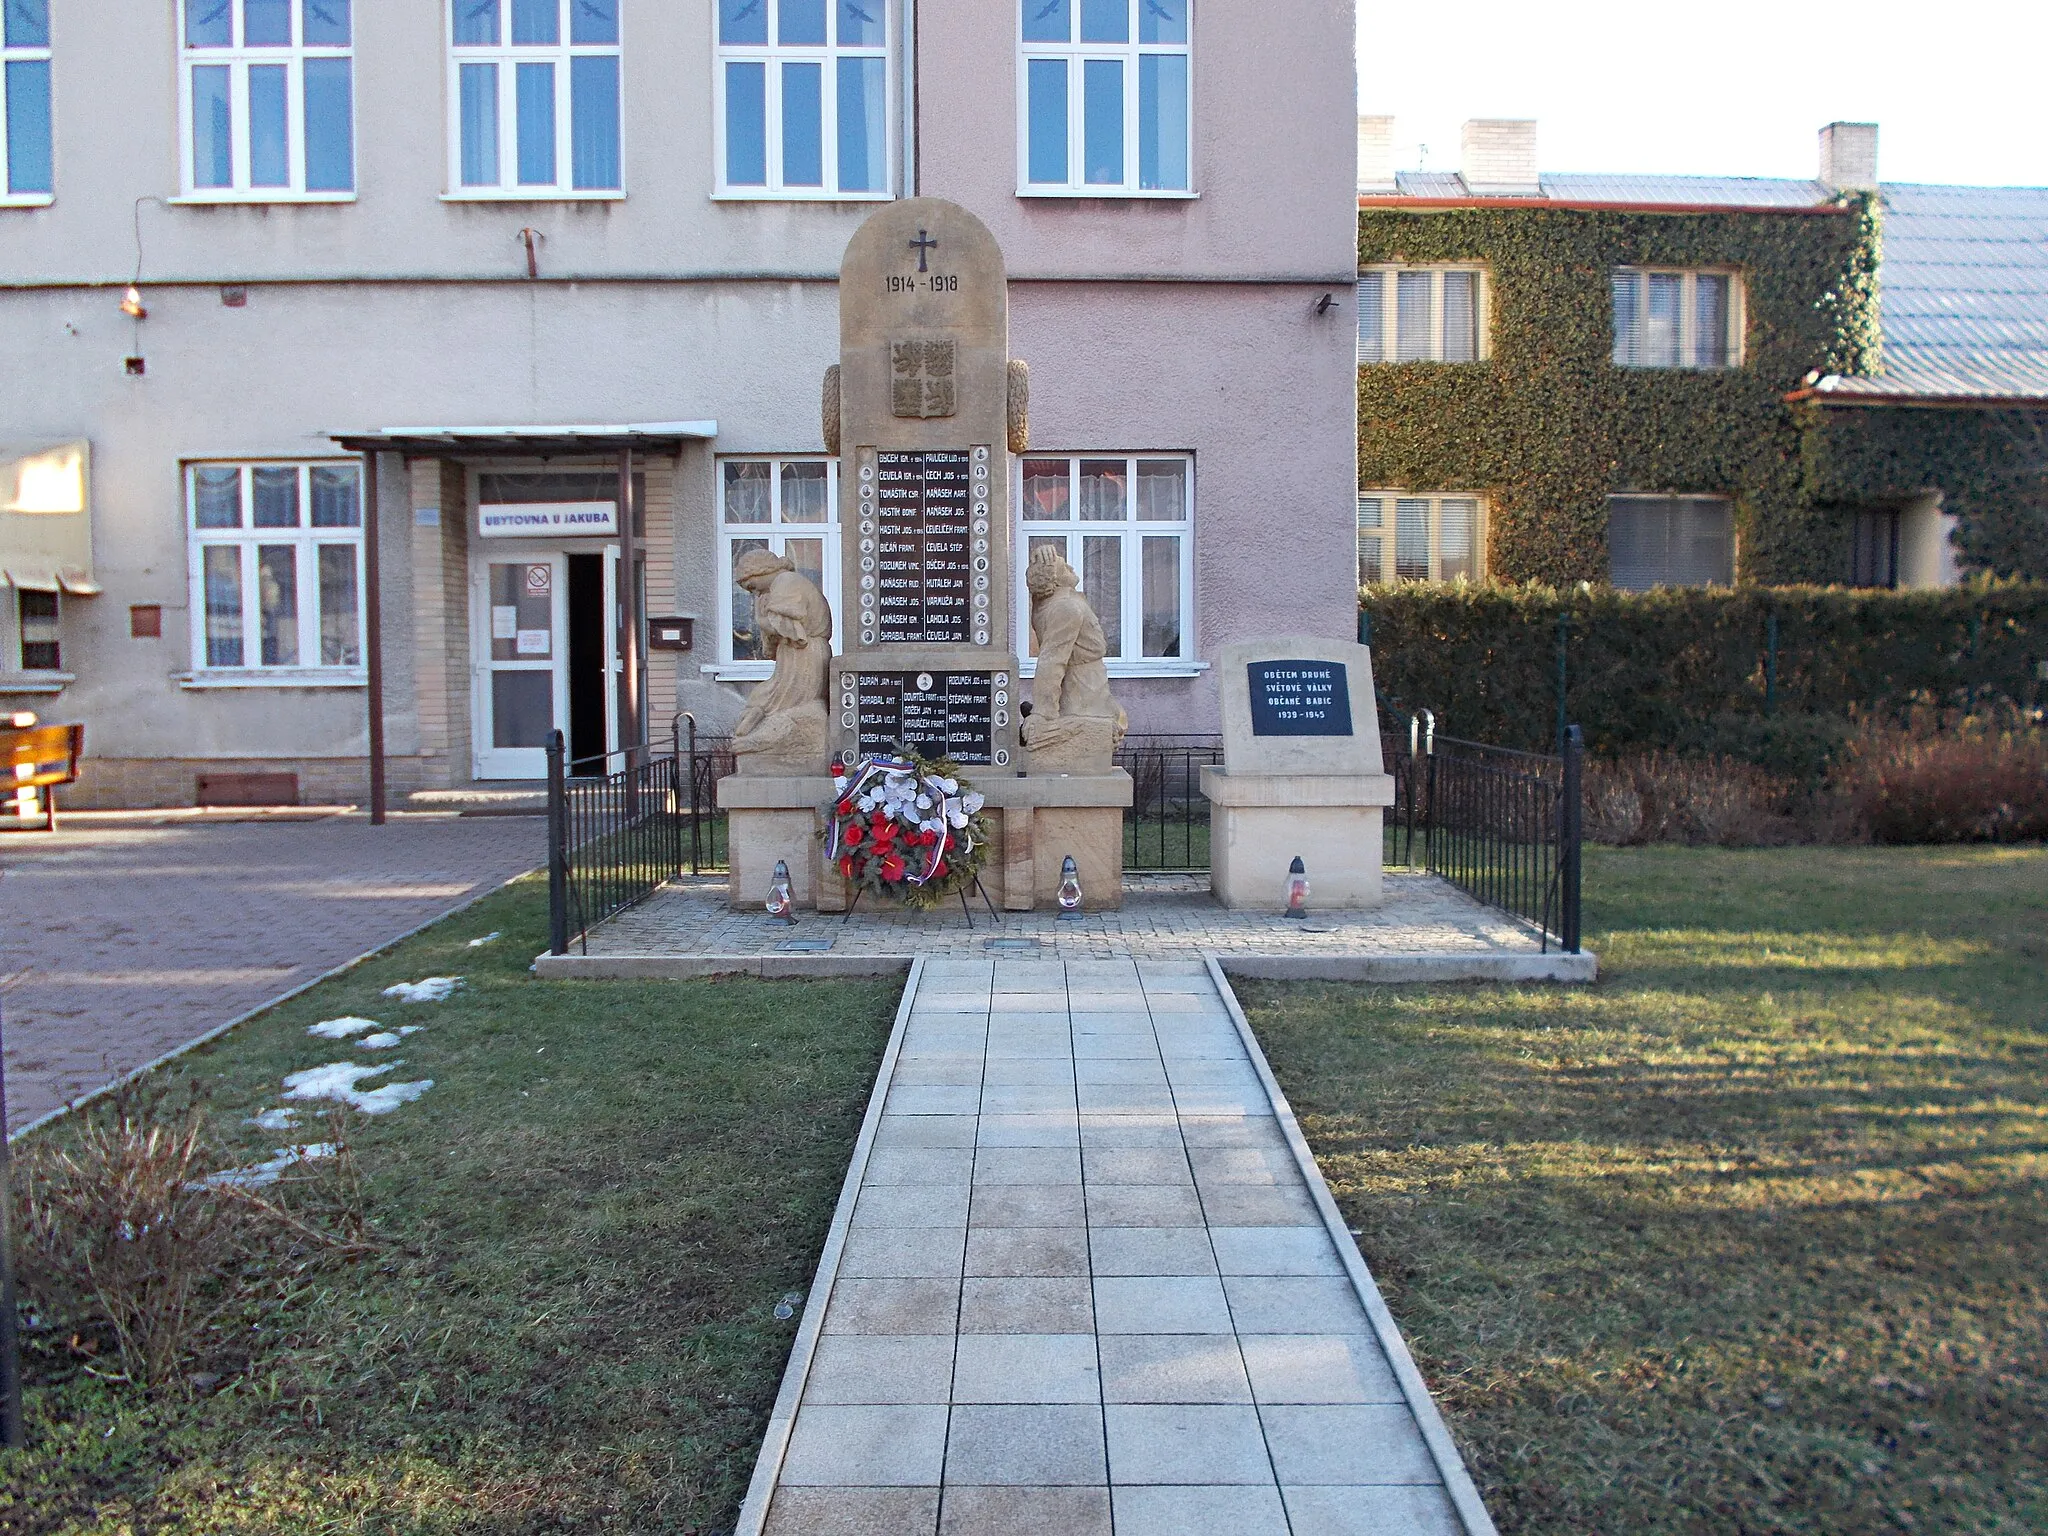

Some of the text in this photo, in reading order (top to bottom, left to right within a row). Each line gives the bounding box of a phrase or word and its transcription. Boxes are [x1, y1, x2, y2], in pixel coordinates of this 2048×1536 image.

[886, 276, 915, 292] 1914
[930, 276, 957, 292] 1918
[926, 469, 941, 479] ČECH
[486, 513, 609, 525] UBYTOVNA U JAKUBA
[927, 615, 949, 623] LAHOLA
[1265, 669, 1330, 678] OBĚTEM DRUHÉ
[1266, 682, 1332, 691] SVĚTOVÉ VÁLKY
